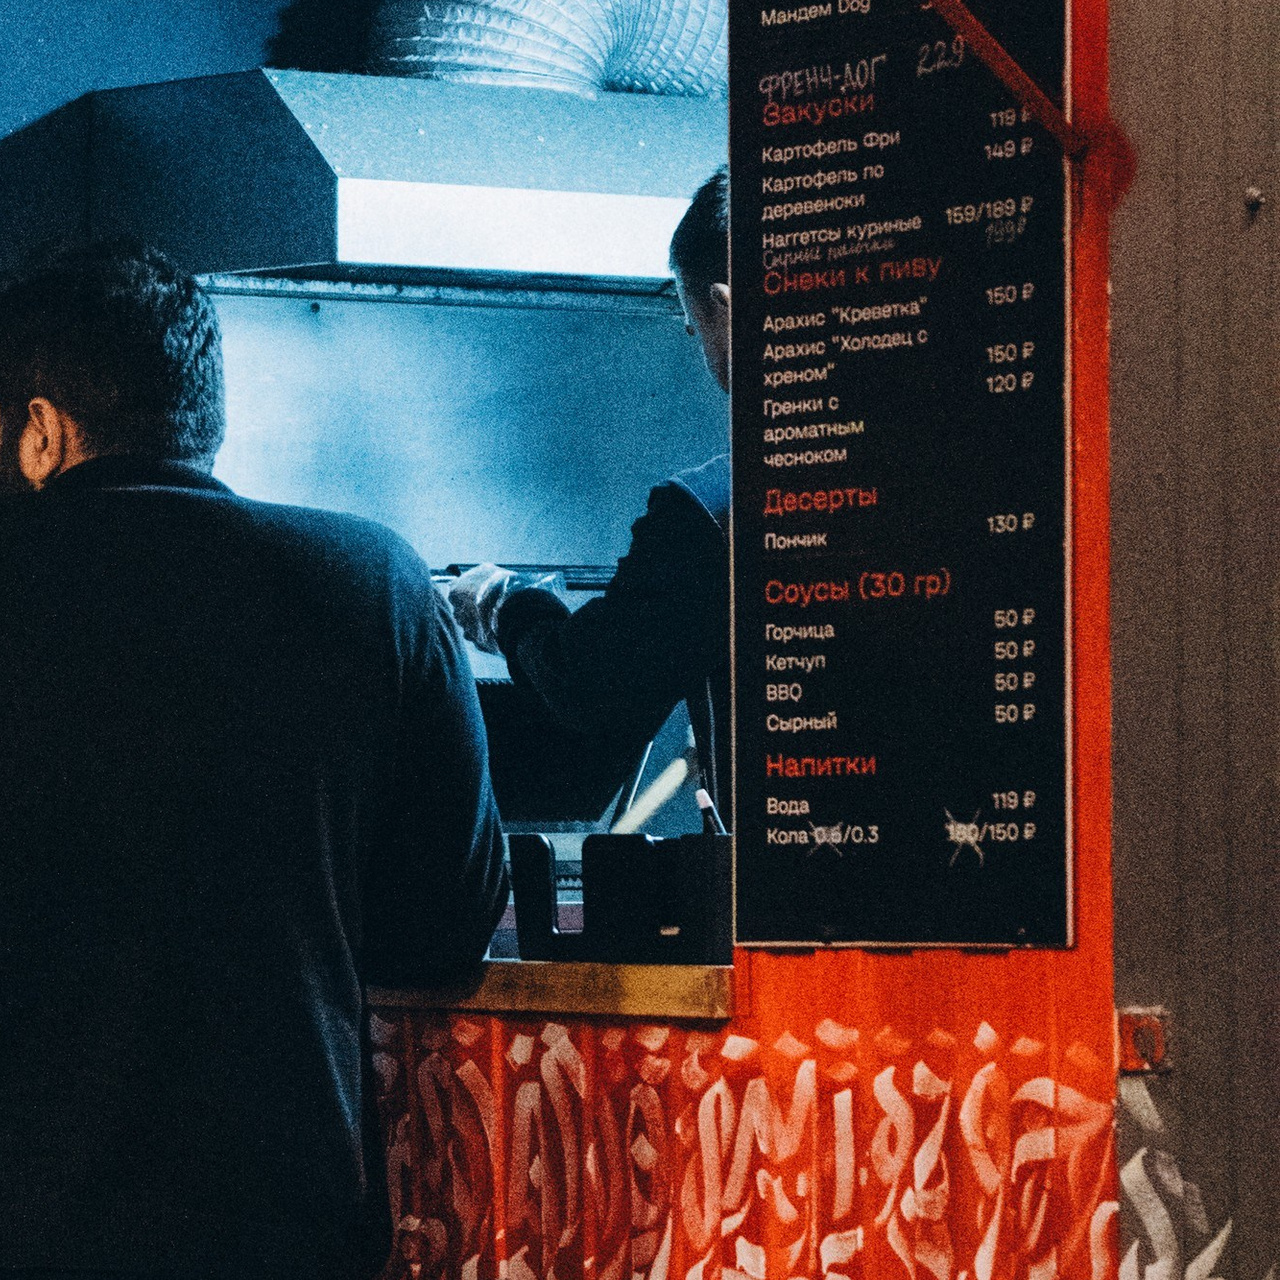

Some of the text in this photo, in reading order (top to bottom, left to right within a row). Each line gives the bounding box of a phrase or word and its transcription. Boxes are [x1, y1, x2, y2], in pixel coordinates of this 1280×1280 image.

[761, 2, 832, 27] Мандем
[762, 93, 874, 126] Закуски
[761, 139, 858, 164] Картофель
[761, 164, 885, 195] Картофель по
[761, 193, 865, 222] деревенски
[762, 215, 923, 250] Наггетсы куриные
[763, 256, 944, 296] Снеки к пиву
[985, 286, 1018, 307] 150
[762, 310, 827, 333] Арахис
[762, 339, 827, 362] Арахис
[986, 345, 1018, 364] 150
[986, 374, 1018, 394] 120
[762, 398, 824, 420] Гренки
[763, 420, 866, 446] ароматным
[763, 447, 849, 469] чесноком
[762, 487, 879, 517] Десерты
[986, 514, 1019, 534] 130
[764, 532, 829, 551] Пончик
[764, 567, 953, 608] Соусы (30 гр)
[994, 609, 1019, 628] 50
[765, 623, 837, 646] Горчица
[994, 641, 1019, 660] 50
[765, 654, 827, 673] Кетчуп
[765, 683, 804, 702] BBQ
[994, 673, 1019, 691] 50
[766, 711, 839, 733] Сырный
[994, 704, 1019, 723] 50
[765, 753, 878, 777] Напитки
[766, 796, 811, 816] Вода
[992, 790, 1019, 810] 119
[766, 827, 810, 845] Кола
